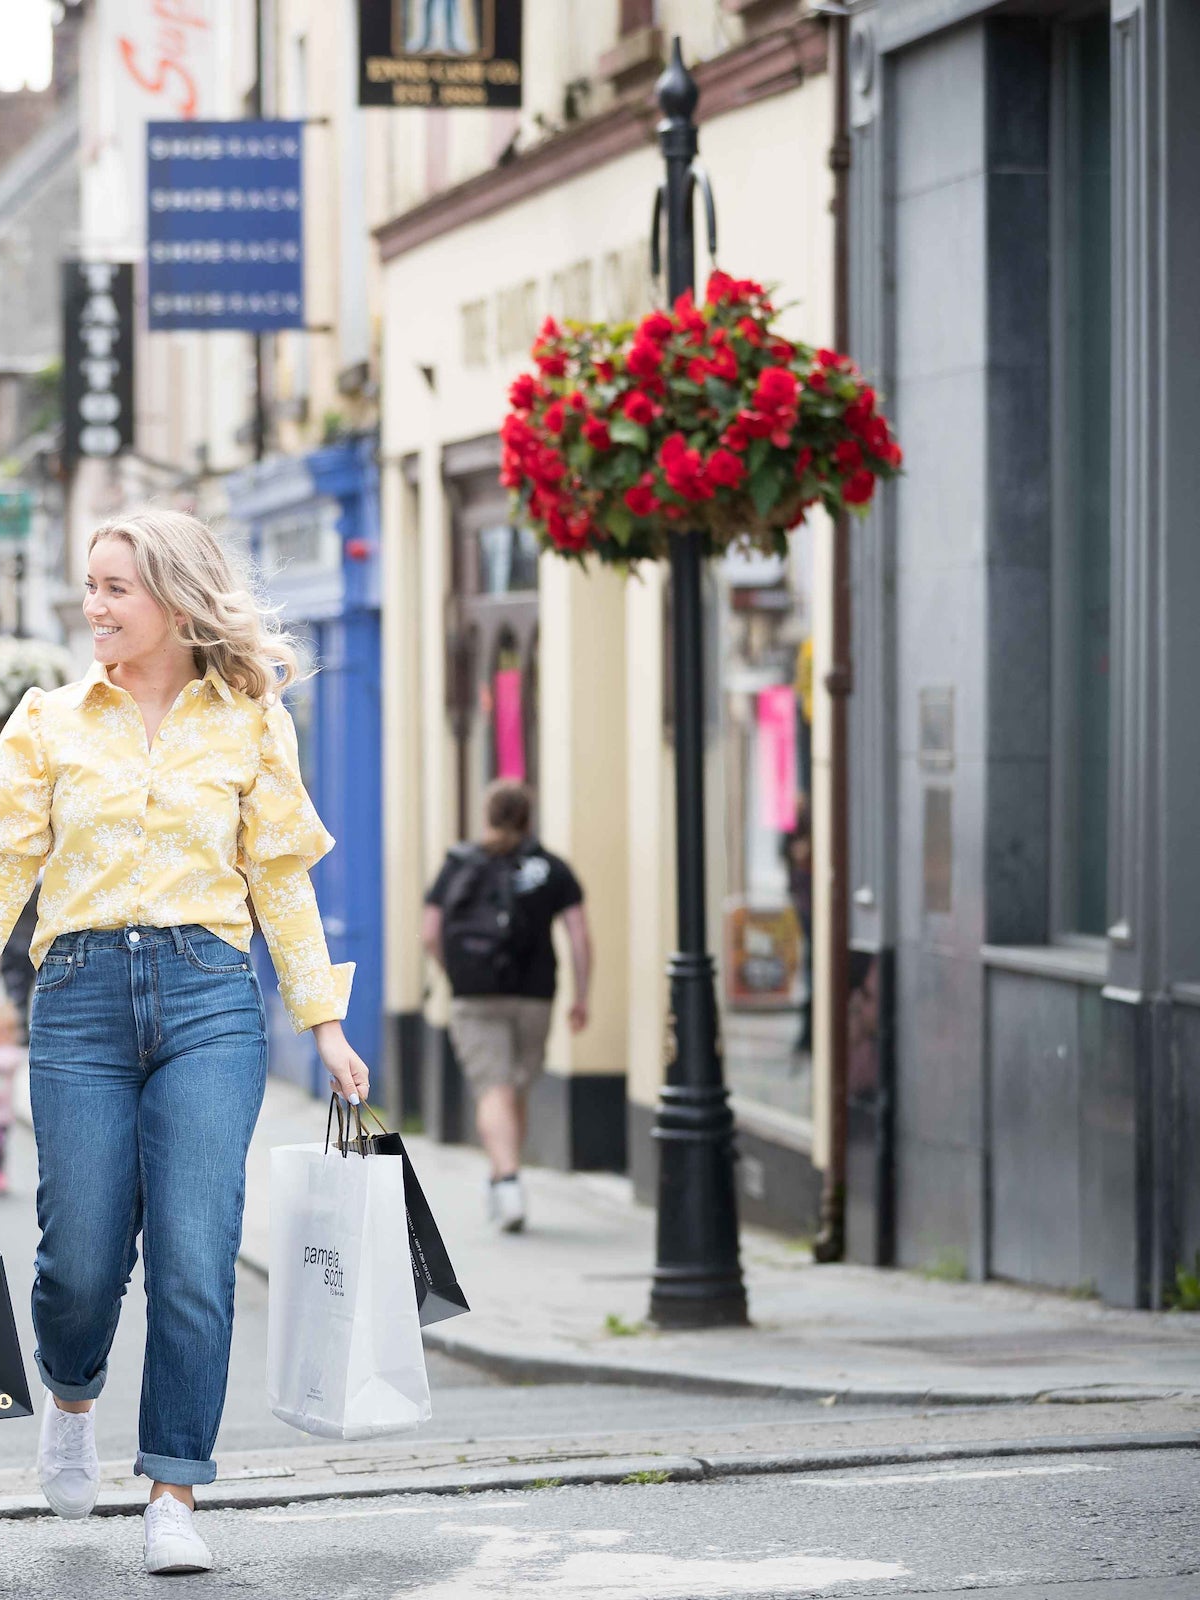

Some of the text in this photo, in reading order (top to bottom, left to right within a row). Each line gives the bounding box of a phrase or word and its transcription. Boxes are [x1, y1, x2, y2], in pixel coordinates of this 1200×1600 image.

[78, 262, 122, 457] TATTOO
[303, 1244, 339, 1268] pamela
[324, 1267, 343, 1288] scott
